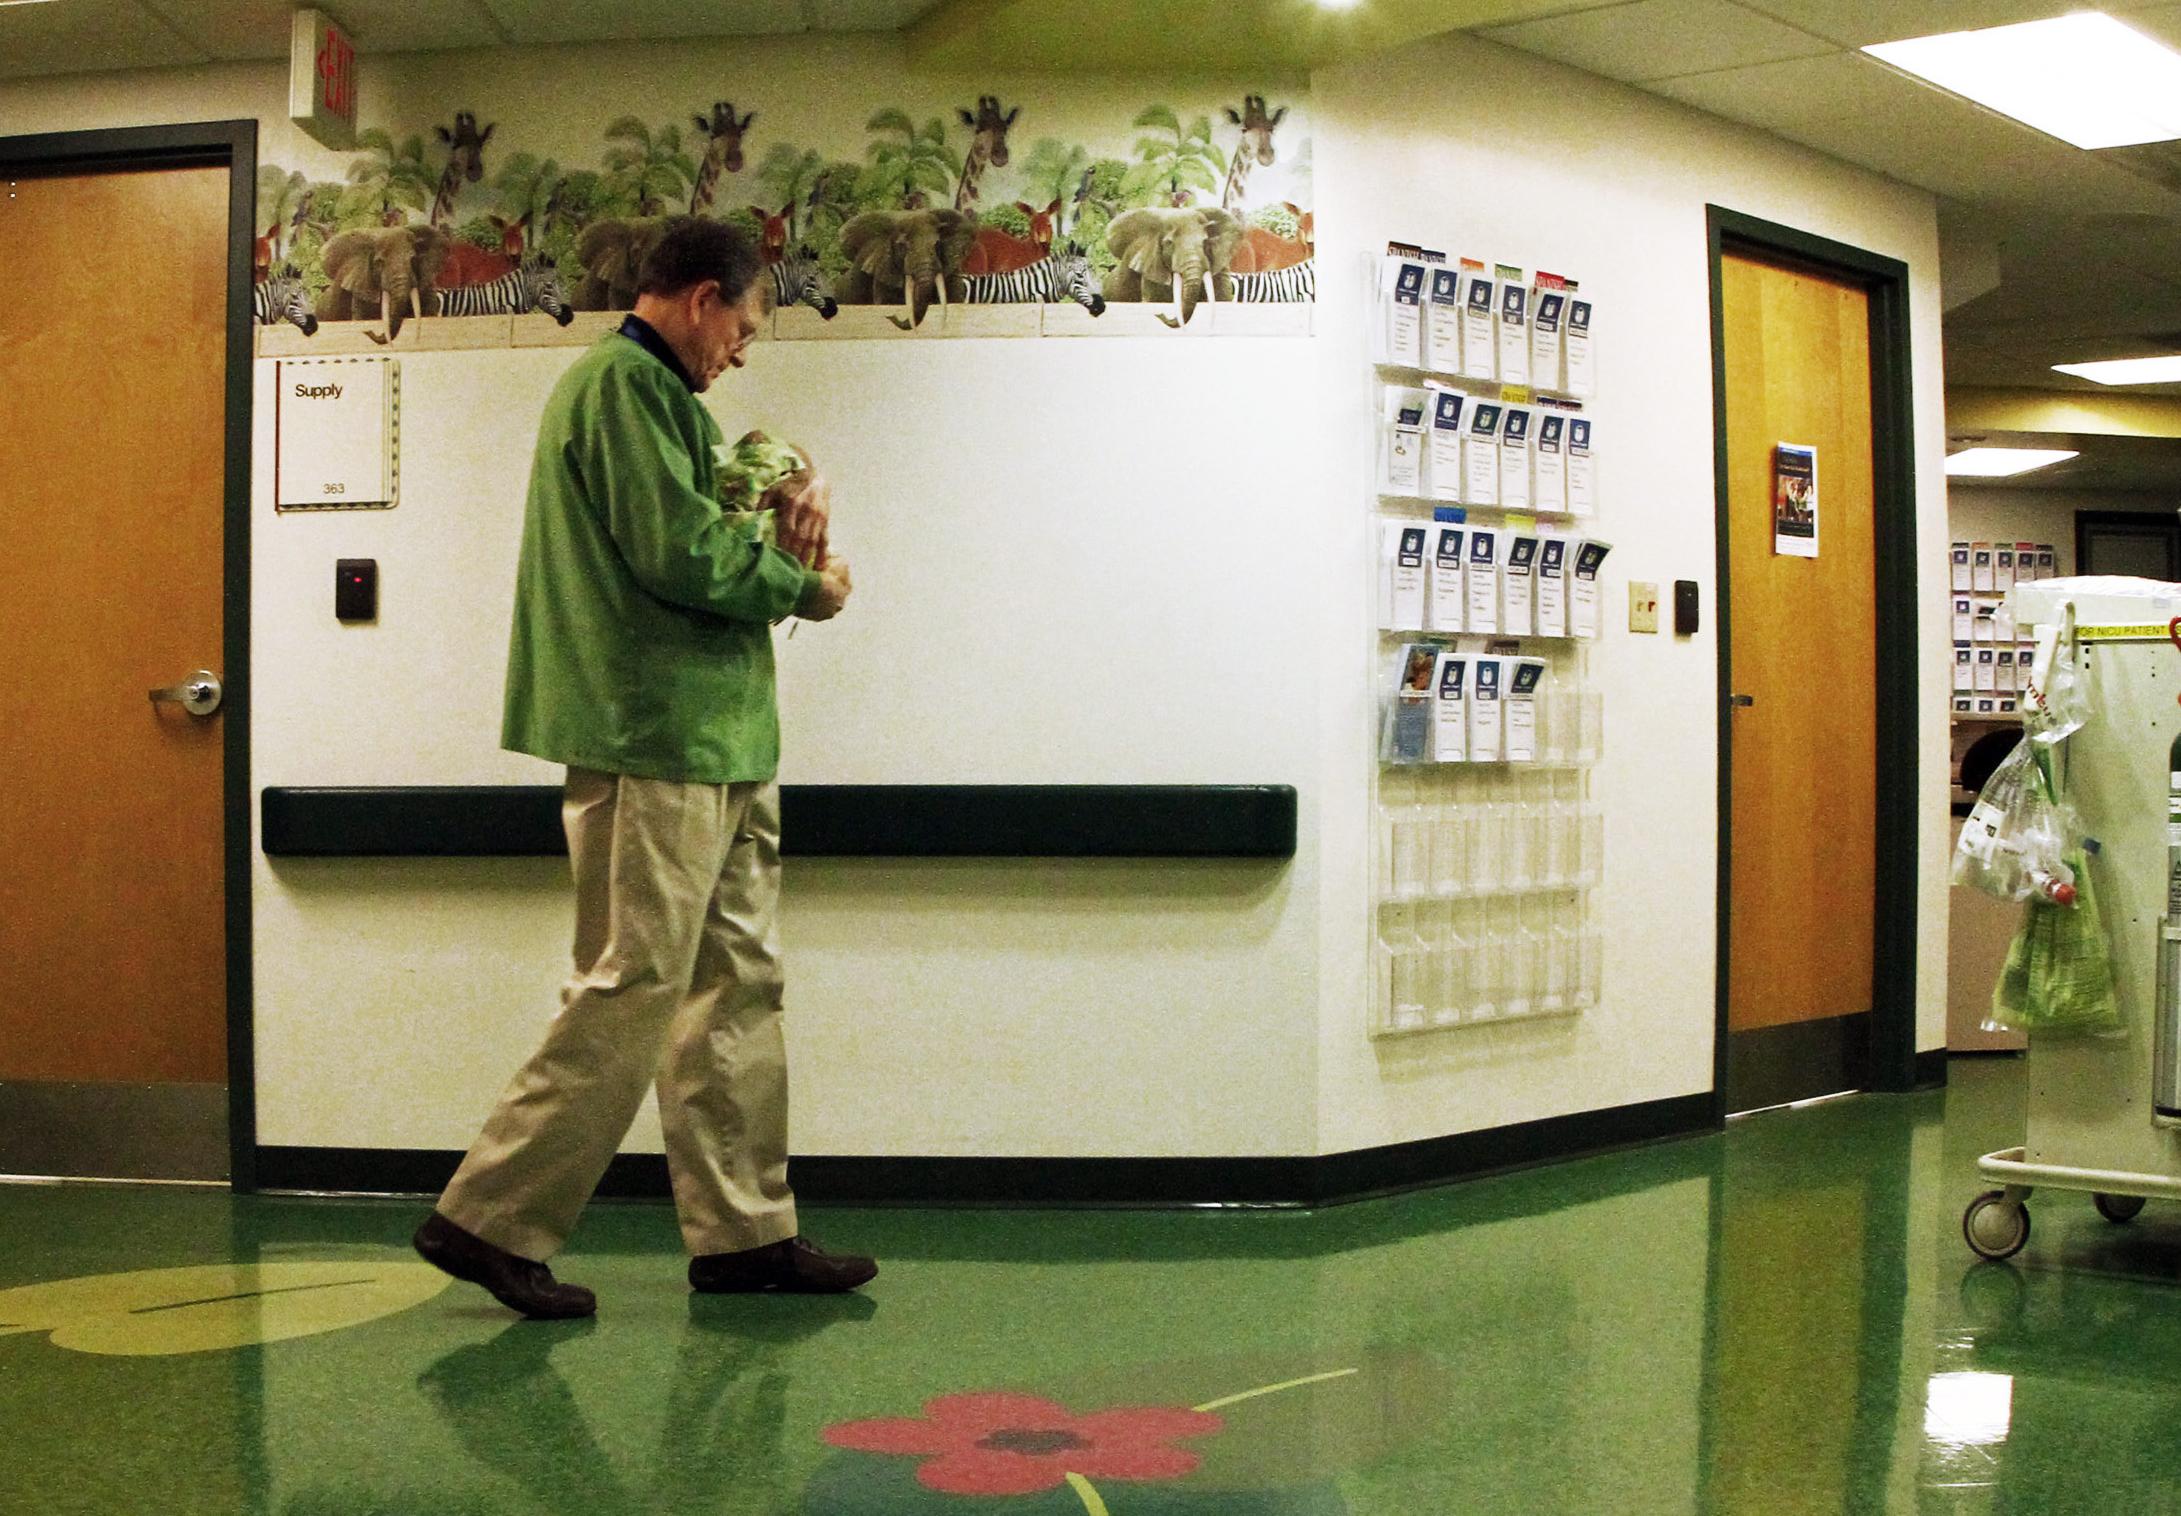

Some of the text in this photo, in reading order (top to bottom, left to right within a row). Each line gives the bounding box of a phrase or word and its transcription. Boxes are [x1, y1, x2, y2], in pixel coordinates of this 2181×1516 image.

[295, 383, 343, 399] Supply
[323, 483, 345, 494] 363
[2097, 626, 2121, 637] NICU
[2124, 625, 2166, 636] PATIENT
